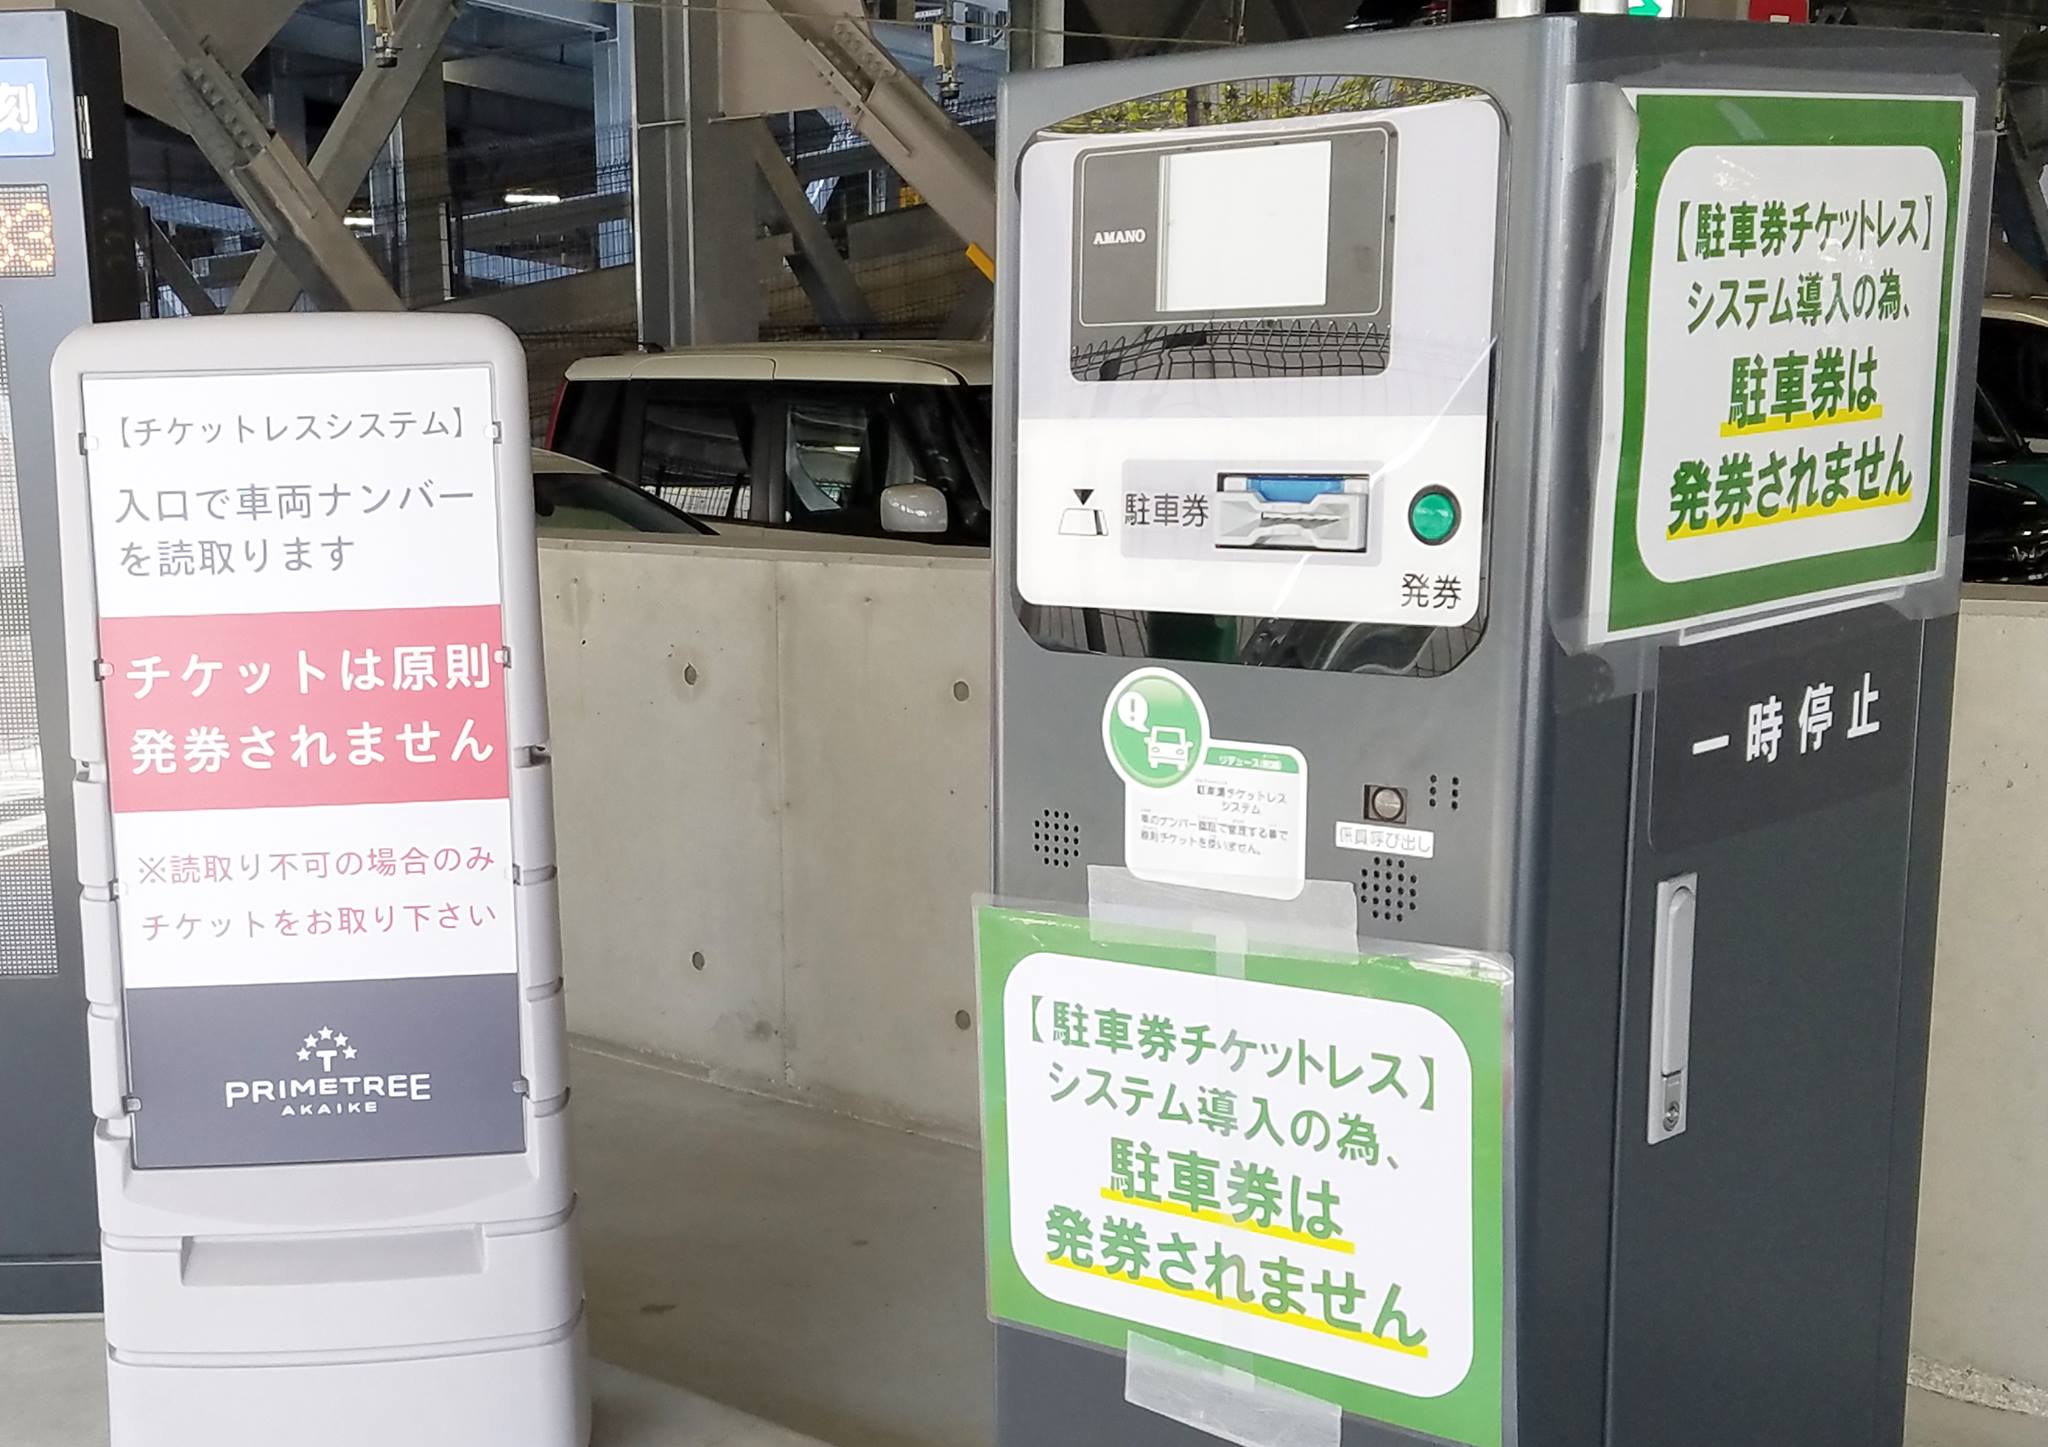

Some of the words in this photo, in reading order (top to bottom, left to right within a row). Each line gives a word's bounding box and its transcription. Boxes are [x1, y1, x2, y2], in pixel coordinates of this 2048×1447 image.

[1093, 229, 1146, 246] AMANO
[1676, 194, 1932, 263] 【駐車券チケットレス】
[1687, 267, 1911, 334] システム導入の為、
[1728, 346, 1878, 428] 駐車券は
[121, 407, 463, 449] 【チケットレスシステム】
[115, 478, 475, 524] 入口で車両ナンバー
[1123, 492, 1209, 528] 駐車券
[1668, 433, 1912, 535] 発券されません
[119, 535, 356, 578] を読取ります
[1400, 572, 1463, 610] 発券
[126, 642, 491, 699] チケットは原則
[1692, 672, 1880, 763] 一時停止
[131, 718, 494, 775] 発券されません
[138, 846, 495, 885] ※読取り不可の場合のみ
[142, 902, 497, 941] チケットをお取り下さい
[1031, 994, 1435, 1111] 【駐車券チケットレス】
[225, 1073, 431, 1108] PRIMETREE
[281, 1101, 378, 1117] AKAIKE
[1048, 1061, 1399, 1170] システム導入の為、
[1110, 1136, 1343, 1240] 駐車券は
[1046, 1203, 1427, 1347] 発券されません
